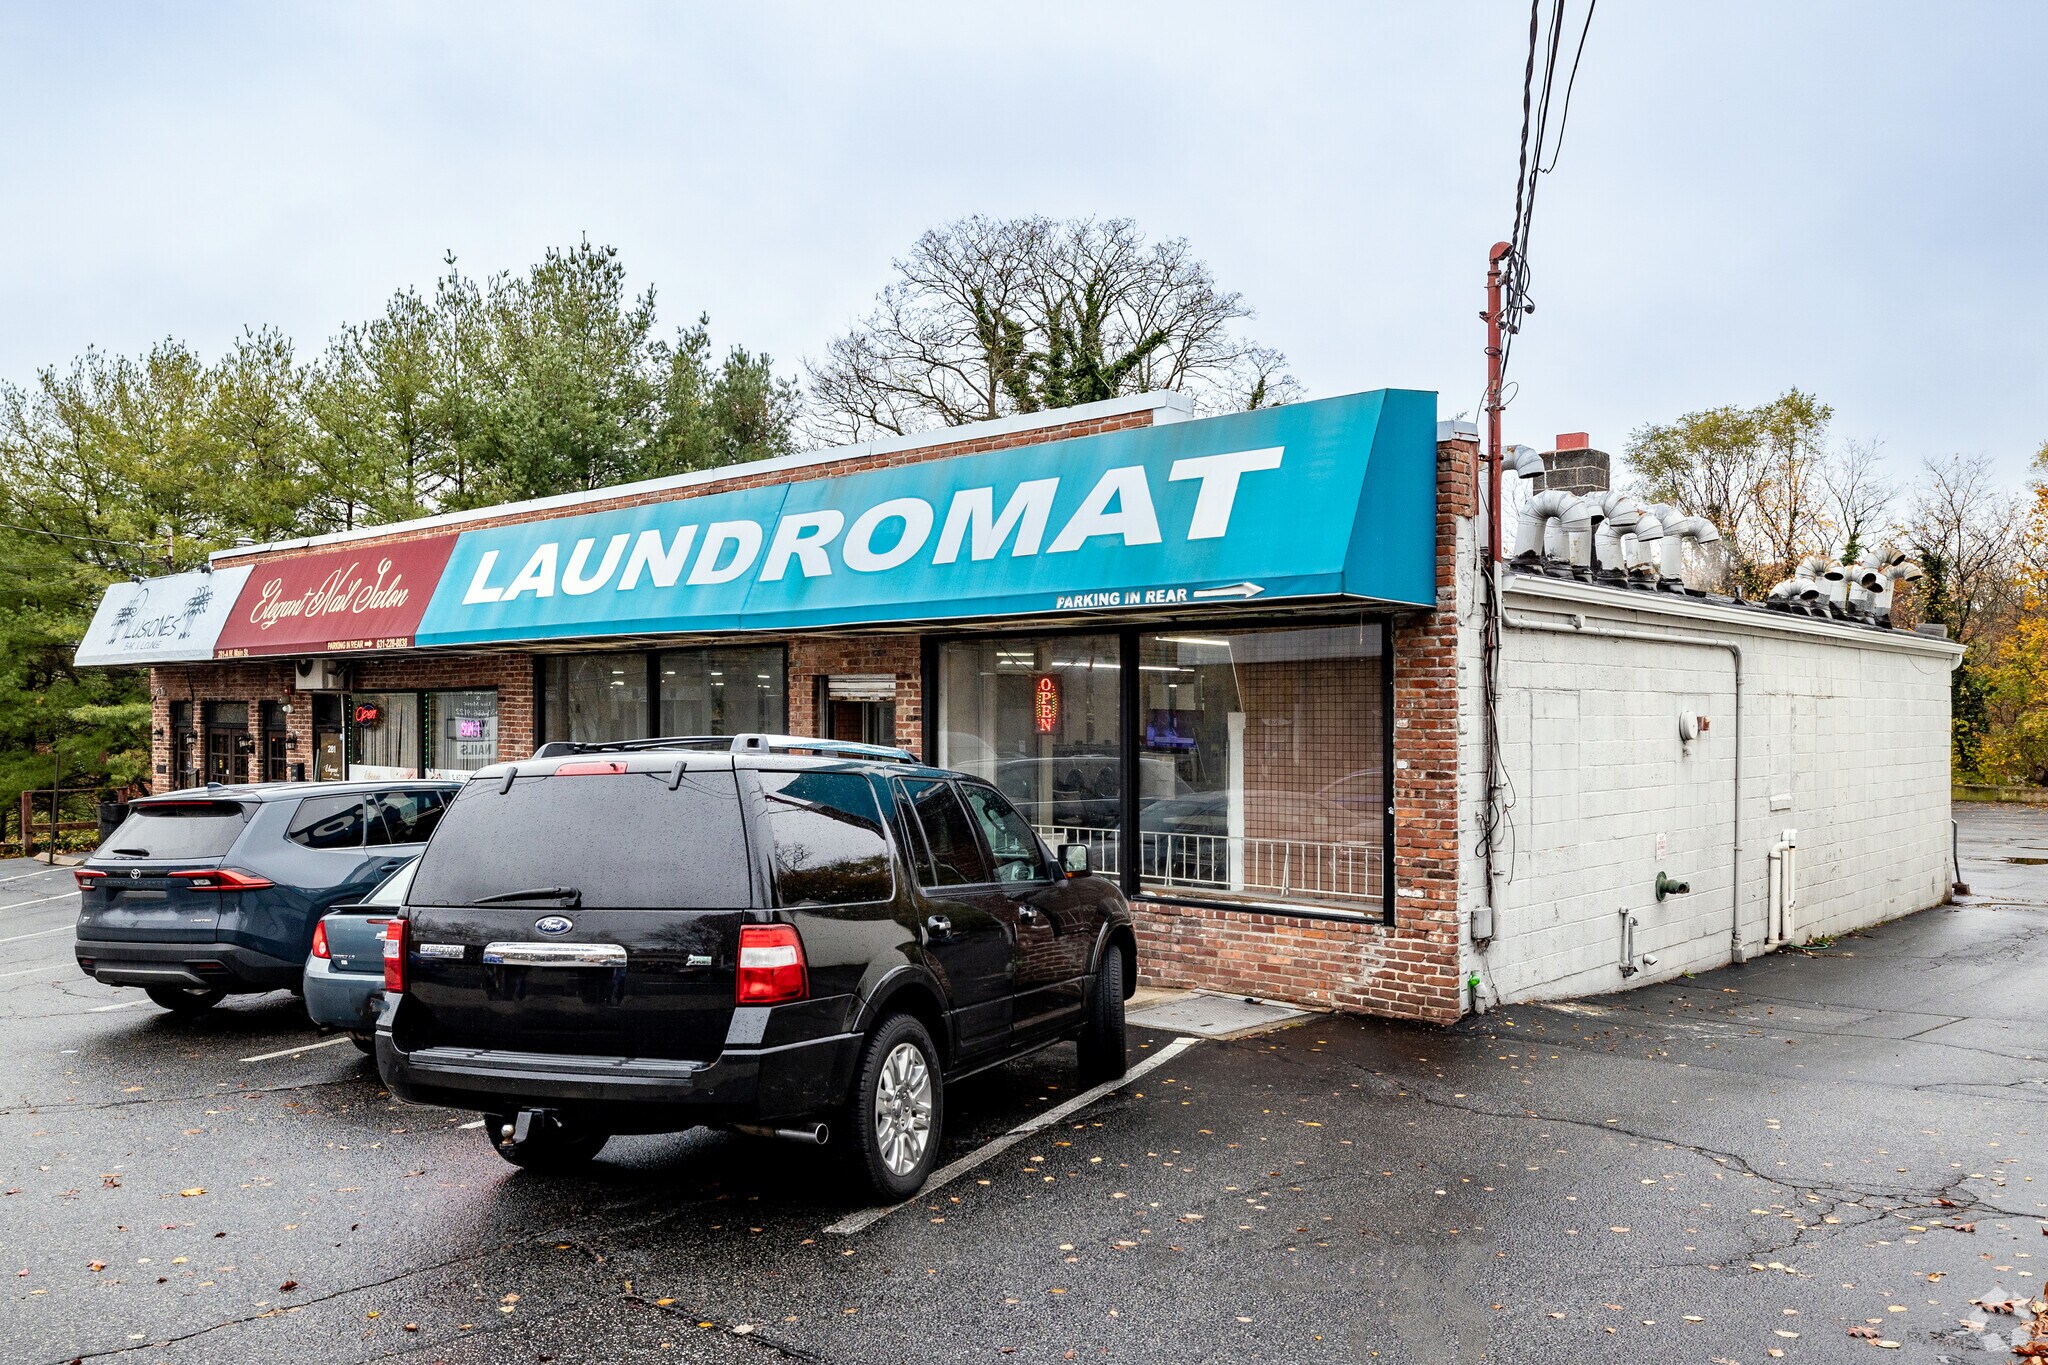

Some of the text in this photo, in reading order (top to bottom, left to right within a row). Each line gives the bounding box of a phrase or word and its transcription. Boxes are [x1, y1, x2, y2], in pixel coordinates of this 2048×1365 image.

[462, 446, 1285, 605] LAUNDROMAT
[250, 557, 408, 630] Elegant Nail Salon
[1056, 588, 1188, 609] PARKING IN REAR
[327, 640, 364, 650] PARKING IN REAR
[1040, 678, 1052, 731] OPEN
[355, 706, 377, 722] Open
[541, 920, 564, 930] Ford
[421, 945, 463, 955] EXPEDITION
